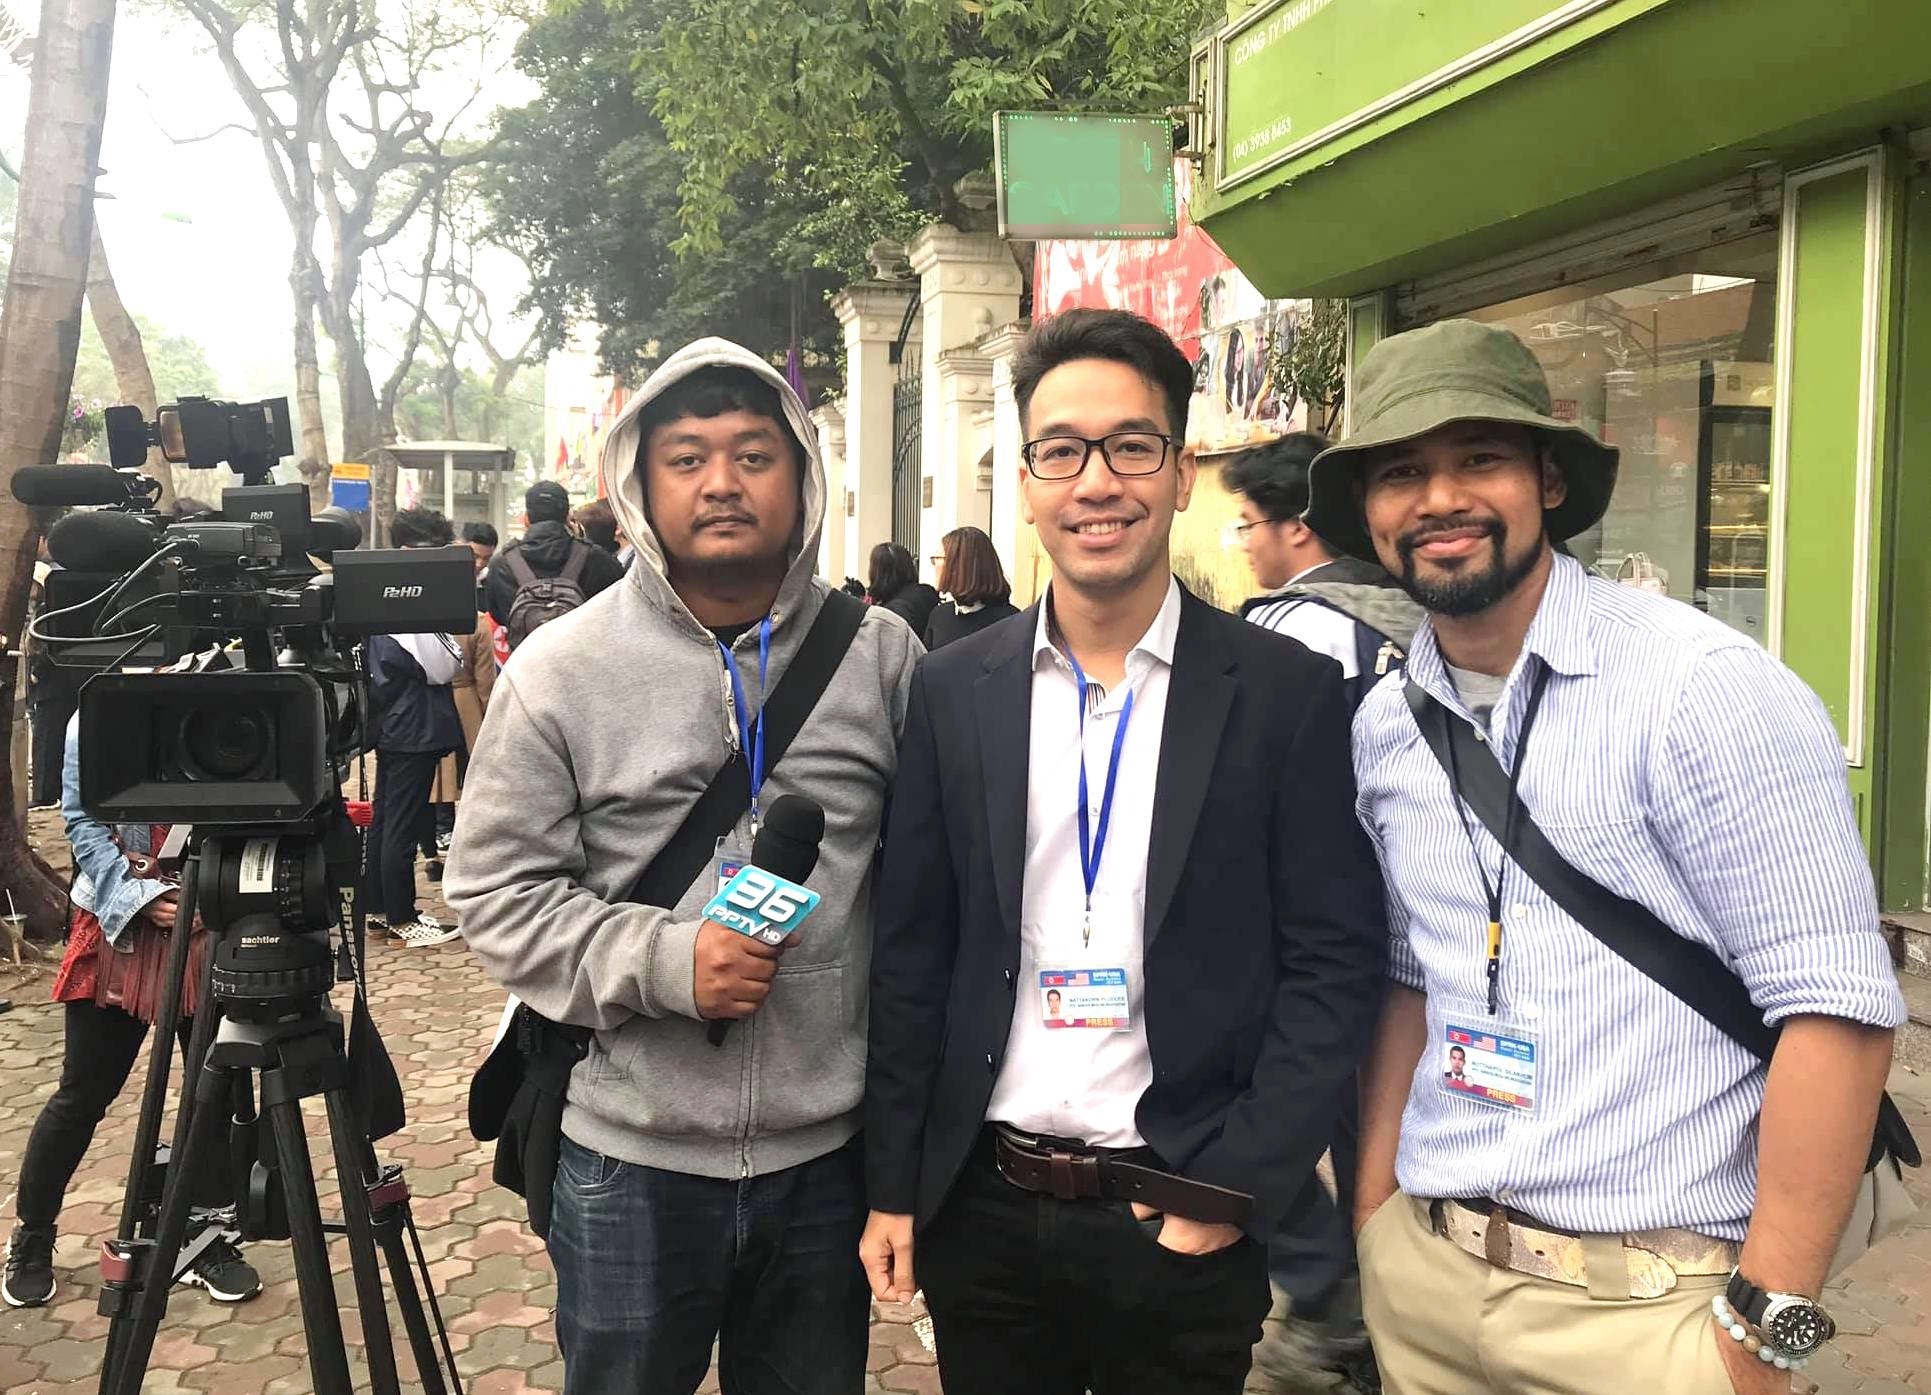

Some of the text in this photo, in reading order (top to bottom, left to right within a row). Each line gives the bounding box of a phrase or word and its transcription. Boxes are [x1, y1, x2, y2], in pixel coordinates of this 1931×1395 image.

[1234, 30, 1266, 65] CÔNG
[1268, 19, 1281, 46] TY
[383, 586, 423, 598] P2HD
[726, 871, 811, 923] 36
[708, 904, 781, 942] PPTV HD
[1486, 1088, 1517, 1103] PRESS
